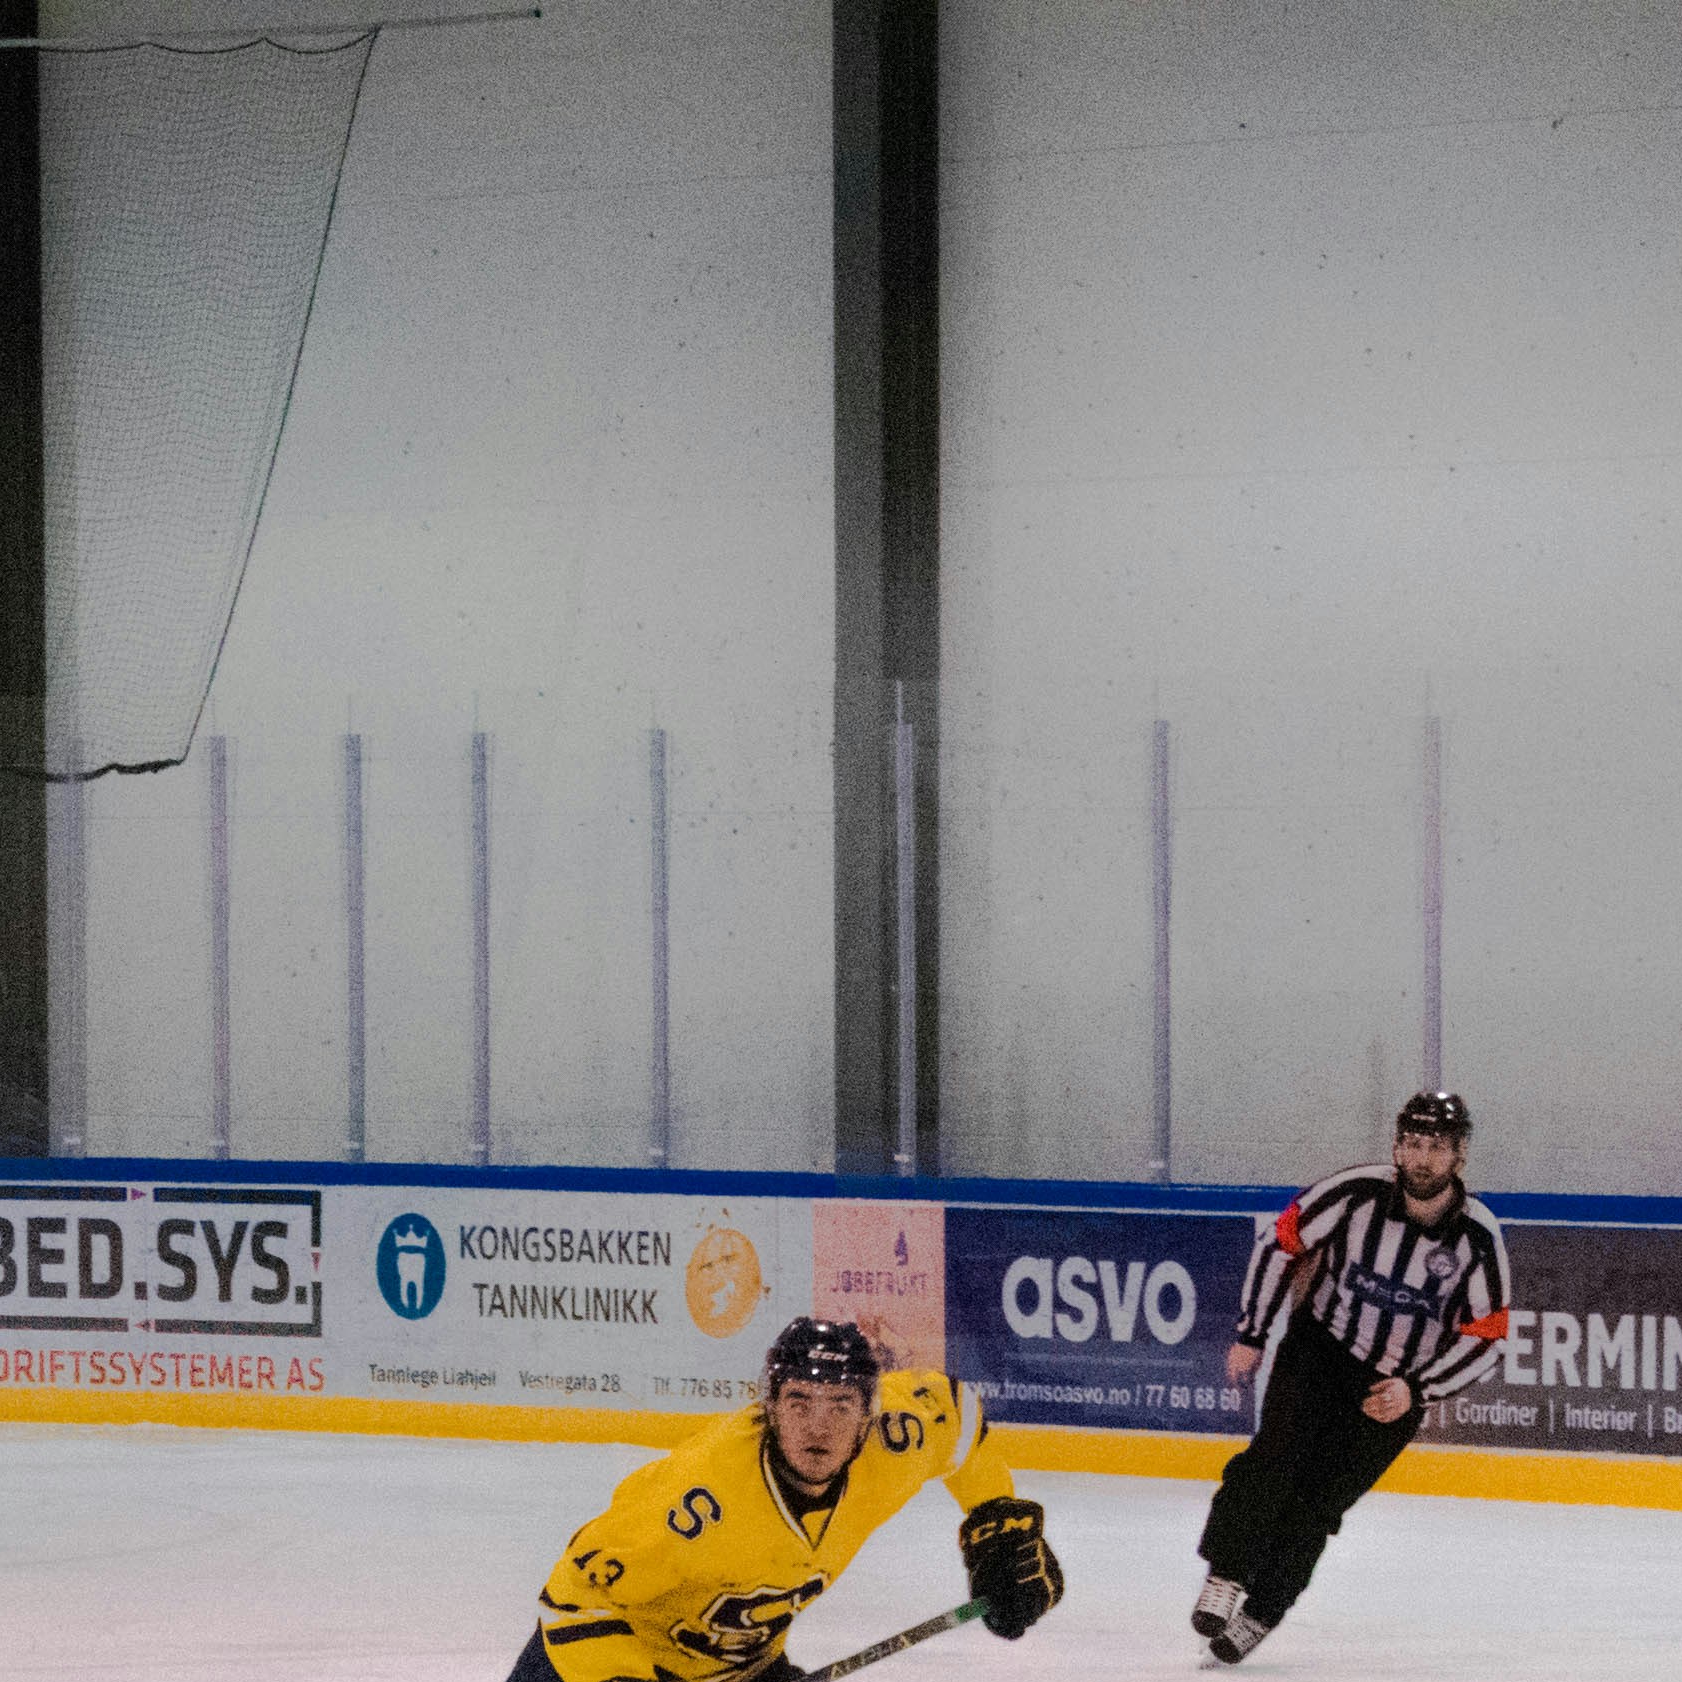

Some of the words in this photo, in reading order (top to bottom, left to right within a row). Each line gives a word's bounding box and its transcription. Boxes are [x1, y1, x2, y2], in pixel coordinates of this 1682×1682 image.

[459, 1224, 672, 1267] KONGSBAKKEN
[473, 1282, 659, 1324] TANNKLINIKK
[1002, 1256, 1197, 1344] asvo
[287, 1357, 326, 1392] AS
[808, 1349, 849, 1362] CCM
[1145, 1384, 1166, 1406] 77
[1455, 1398, 1538, 1427] Gardiner
[666, 1487, 722, 1541] S
